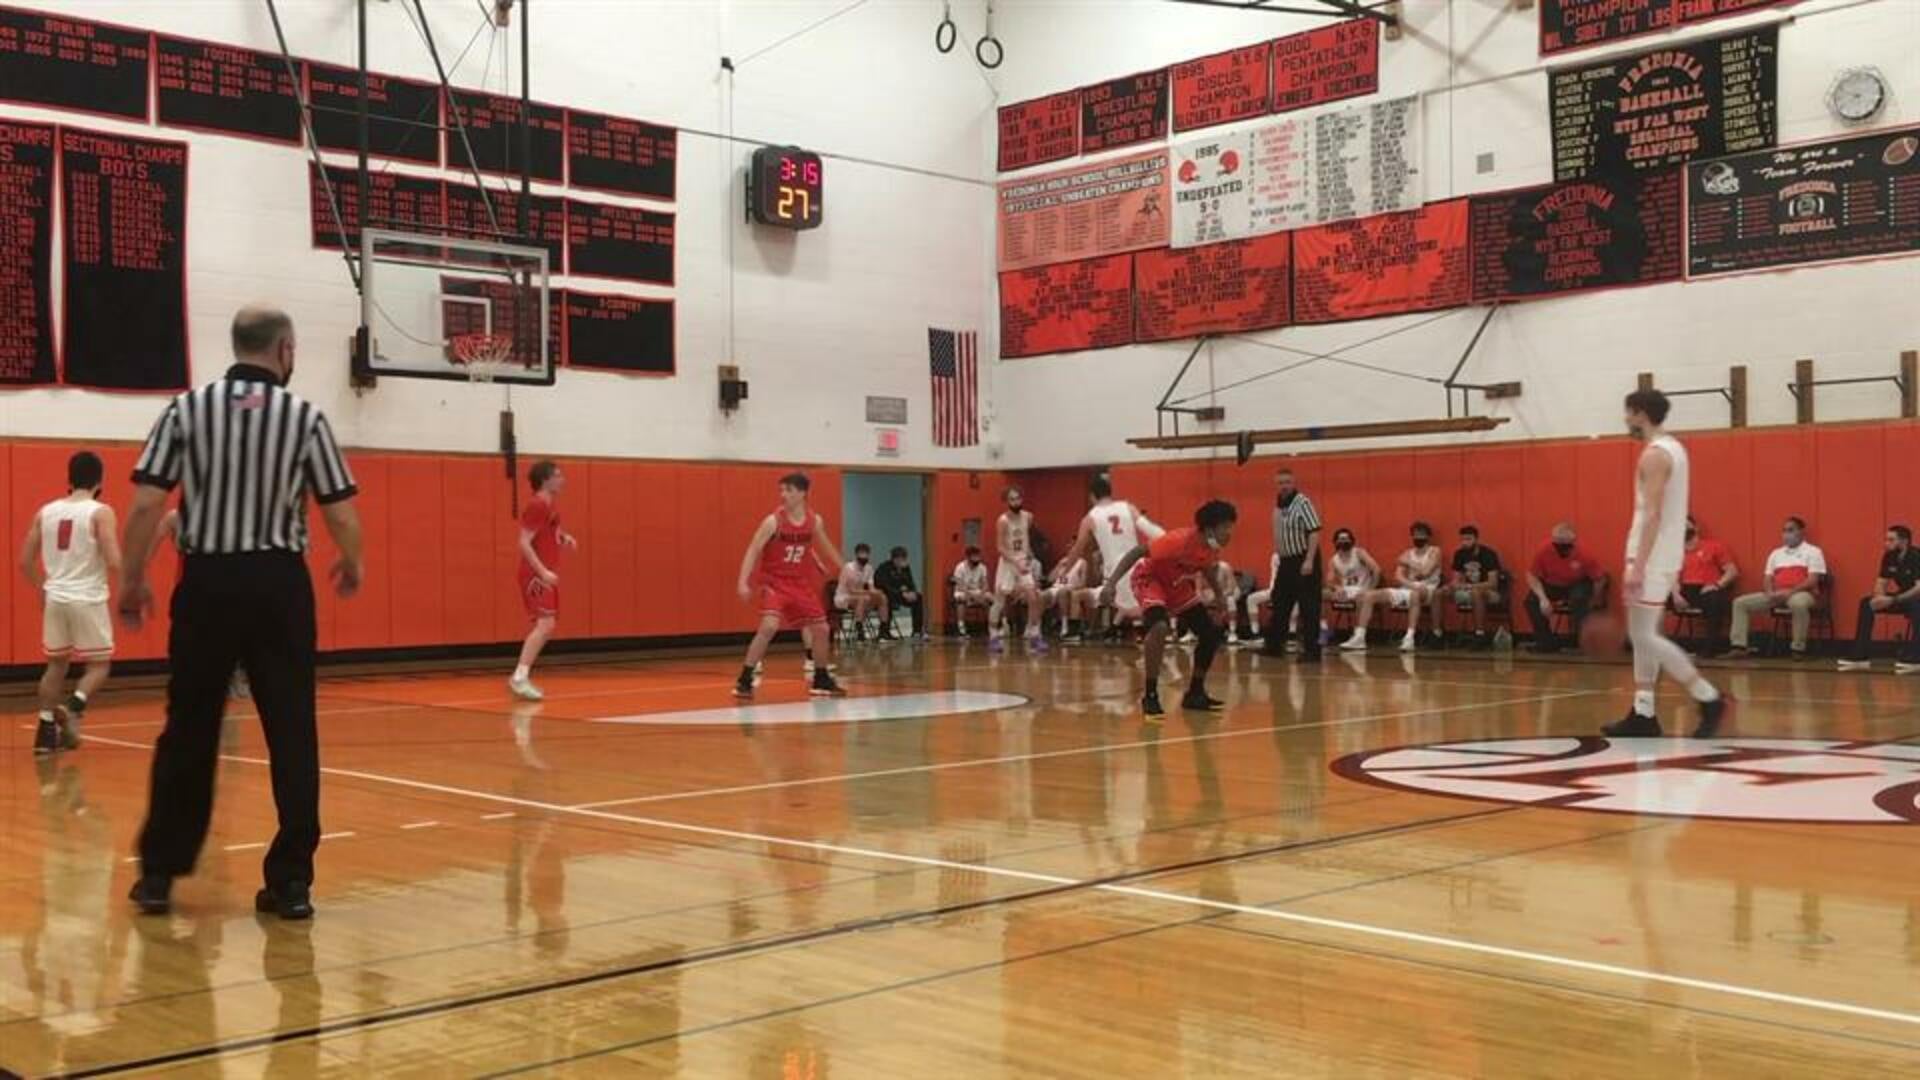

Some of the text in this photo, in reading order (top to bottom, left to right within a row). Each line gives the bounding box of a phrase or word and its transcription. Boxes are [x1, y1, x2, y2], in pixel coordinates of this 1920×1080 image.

[1197, 69, 1243, 90] DISCUS
[1290, 61, 1358, 88] CHAMPION
[1617, 51, 1704, 94] FREDONIA
[1189, 86, 1251, 109] CHAMPION
[1619, 84, 1705, 113] BASEBALL
[63, 134, 184, 165] SECTIONAL CHAMPS
[1625, 136, 1700, 161] CHAMPIONS
[100, 157, 149, 179] BOYS
[781, 157, 819, 185] 3:15
[778, 186, 809, 220] 27
[1176, 180, 1243, 203] UNDEFEATED
[1532, 184, 1616, 222] FREDONIA
[1778, 217, 1838, 236] FOOTBALL
[1107, 515, 1123, 535] 2
[783, 545, 806, 563] 32
